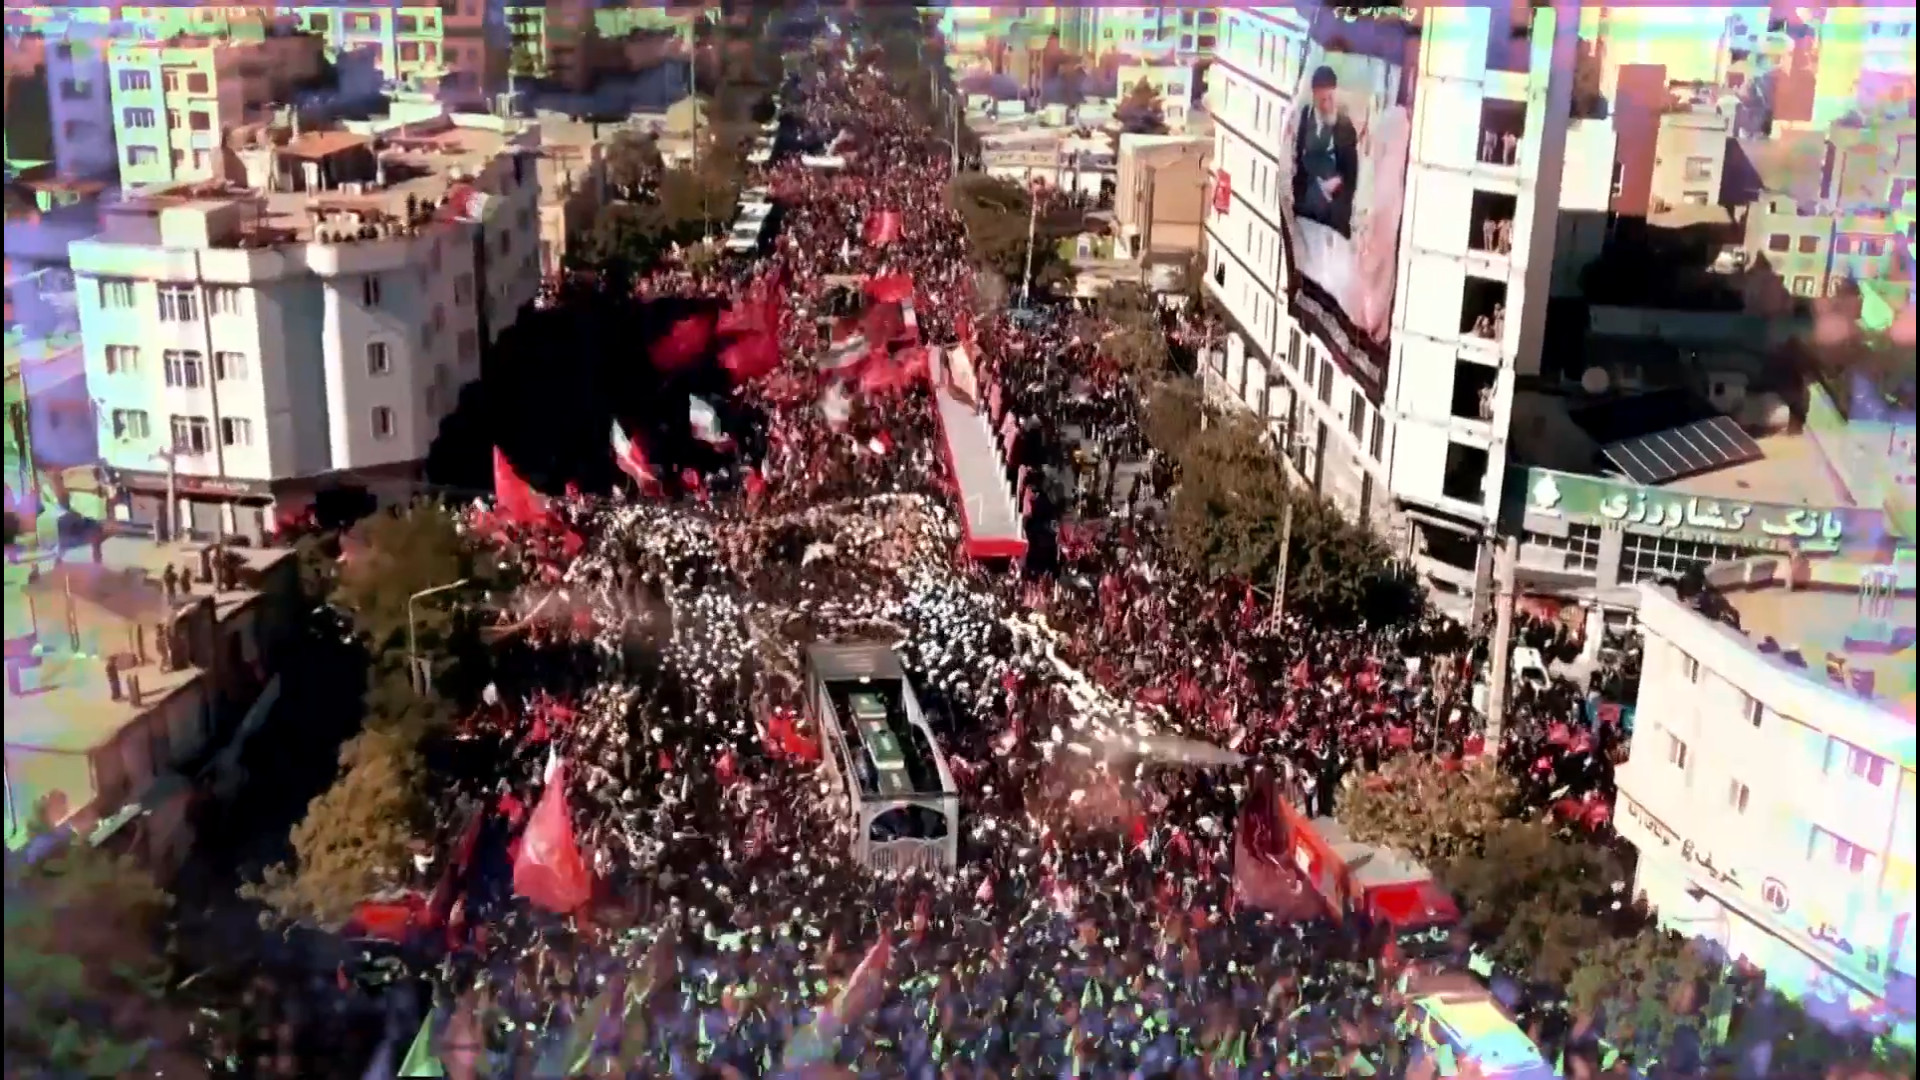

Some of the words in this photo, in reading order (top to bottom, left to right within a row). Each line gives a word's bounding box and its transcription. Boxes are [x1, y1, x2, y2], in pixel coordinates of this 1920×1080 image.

[1599, 491, 1753, 531] کشاورزی
[1762, 506, 1843, 544] بانک
[1807, 921, 1854, 955] هتل
